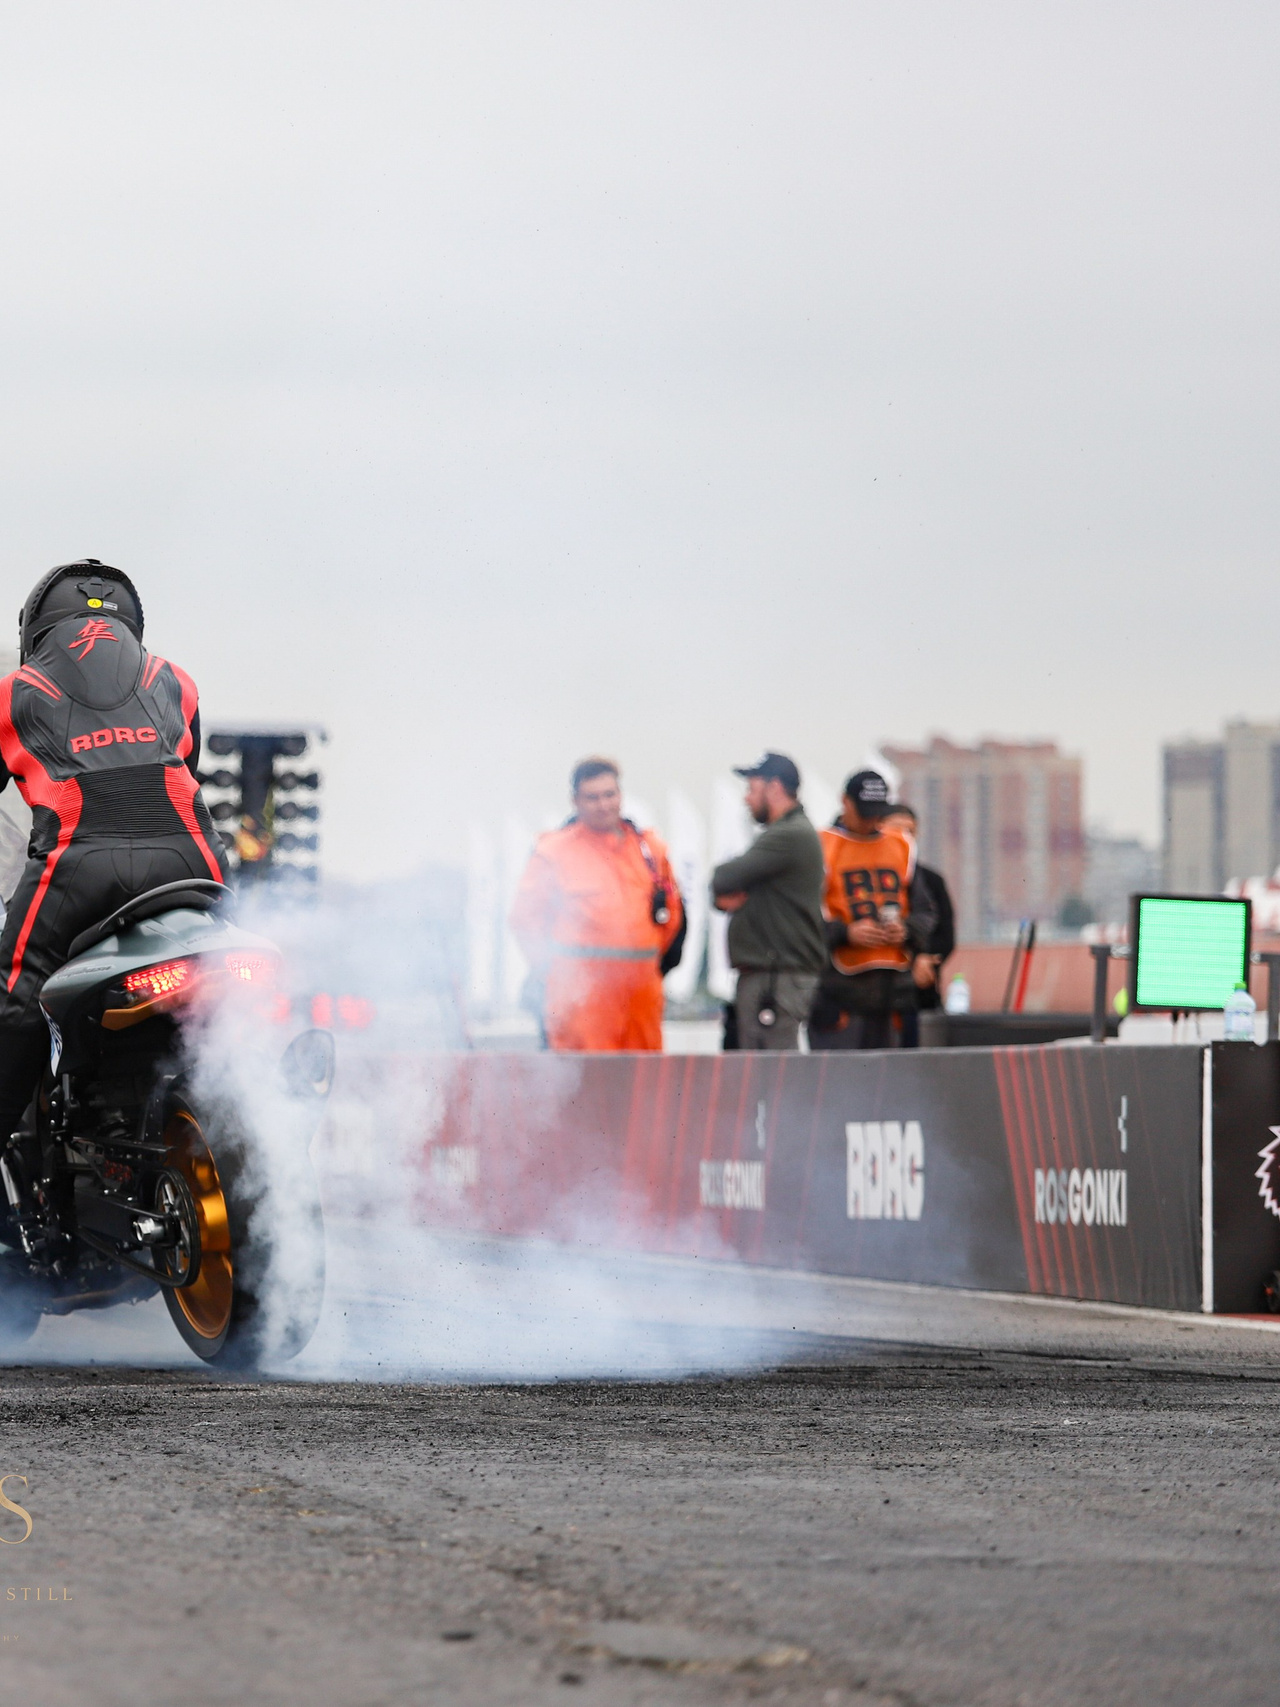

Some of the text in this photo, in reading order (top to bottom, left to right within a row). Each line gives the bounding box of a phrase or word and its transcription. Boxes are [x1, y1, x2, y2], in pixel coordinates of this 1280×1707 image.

[70, 726, 158, 754] RDRC
[846, 1120, 924, 1221] RDRC
[1034, 1167, 1127, 1227] ROSGONKI
